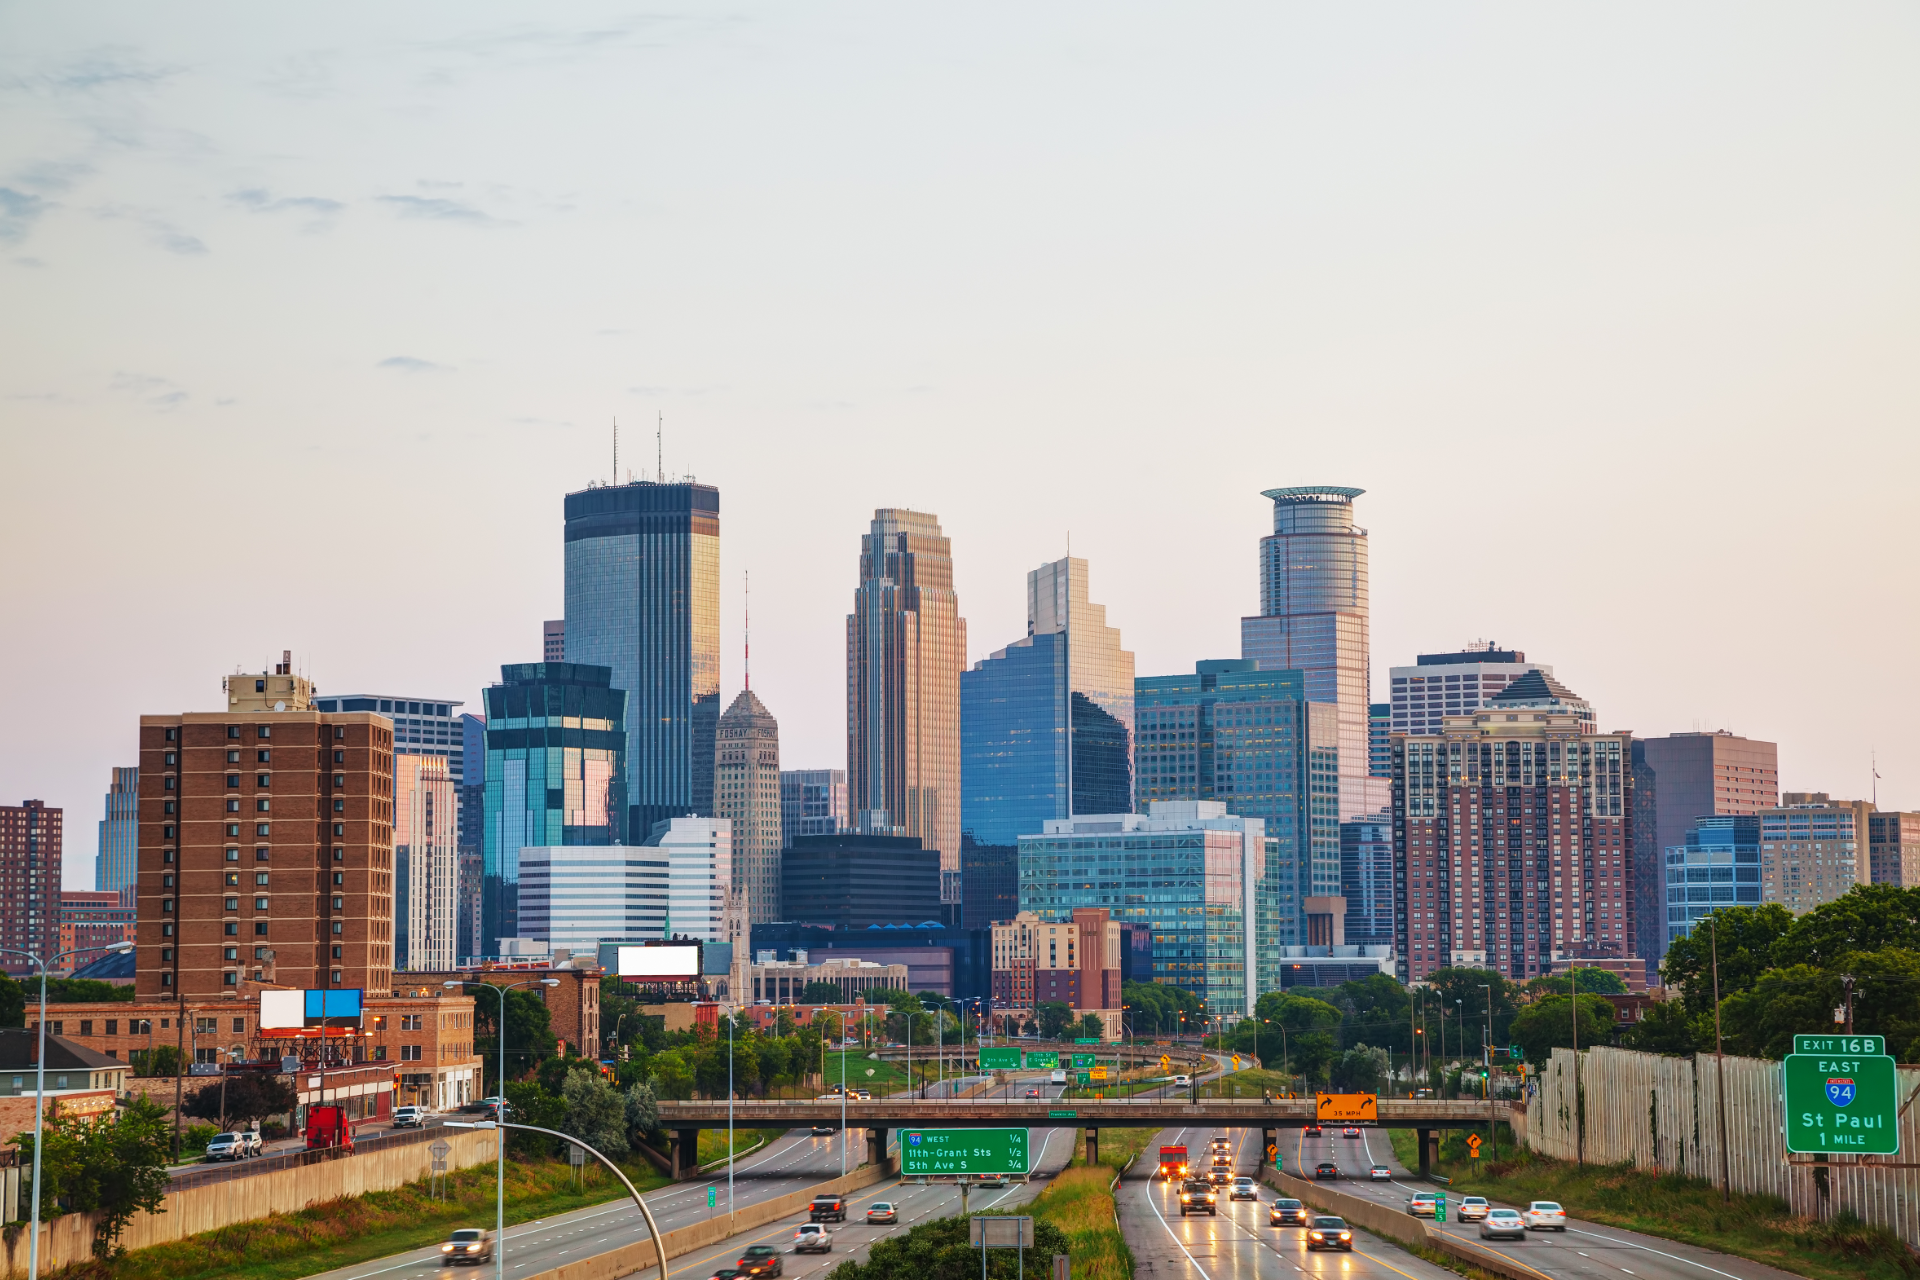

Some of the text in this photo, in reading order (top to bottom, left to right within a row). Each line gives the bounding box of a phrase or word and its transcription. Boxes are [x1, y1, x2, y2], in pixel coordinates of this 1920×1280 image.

[720, 728, 748, 738] FOSHAY
[1803, 1038, 1876, 1053] EXIT 16B
[1818, 1061, 1861, 1073] EAST
[1830, 1085, 1852, 1100] 94
[1802, 1112, 1883, 1129] St Paul
[910, 1136, 921, 1144] 94
[926, 1135, 950, 1143] WEST
[1819, 1132, 1866, 1146] 1 MILE
[908, 1148, 968, 1158] 11th-Grant
[973, 1148, 992, 1157] Sts
[908, 1161, 928, 1170] 5th
[933, 1161, 955, 1170] Ave
[960, 1160, 967, 1170] S
